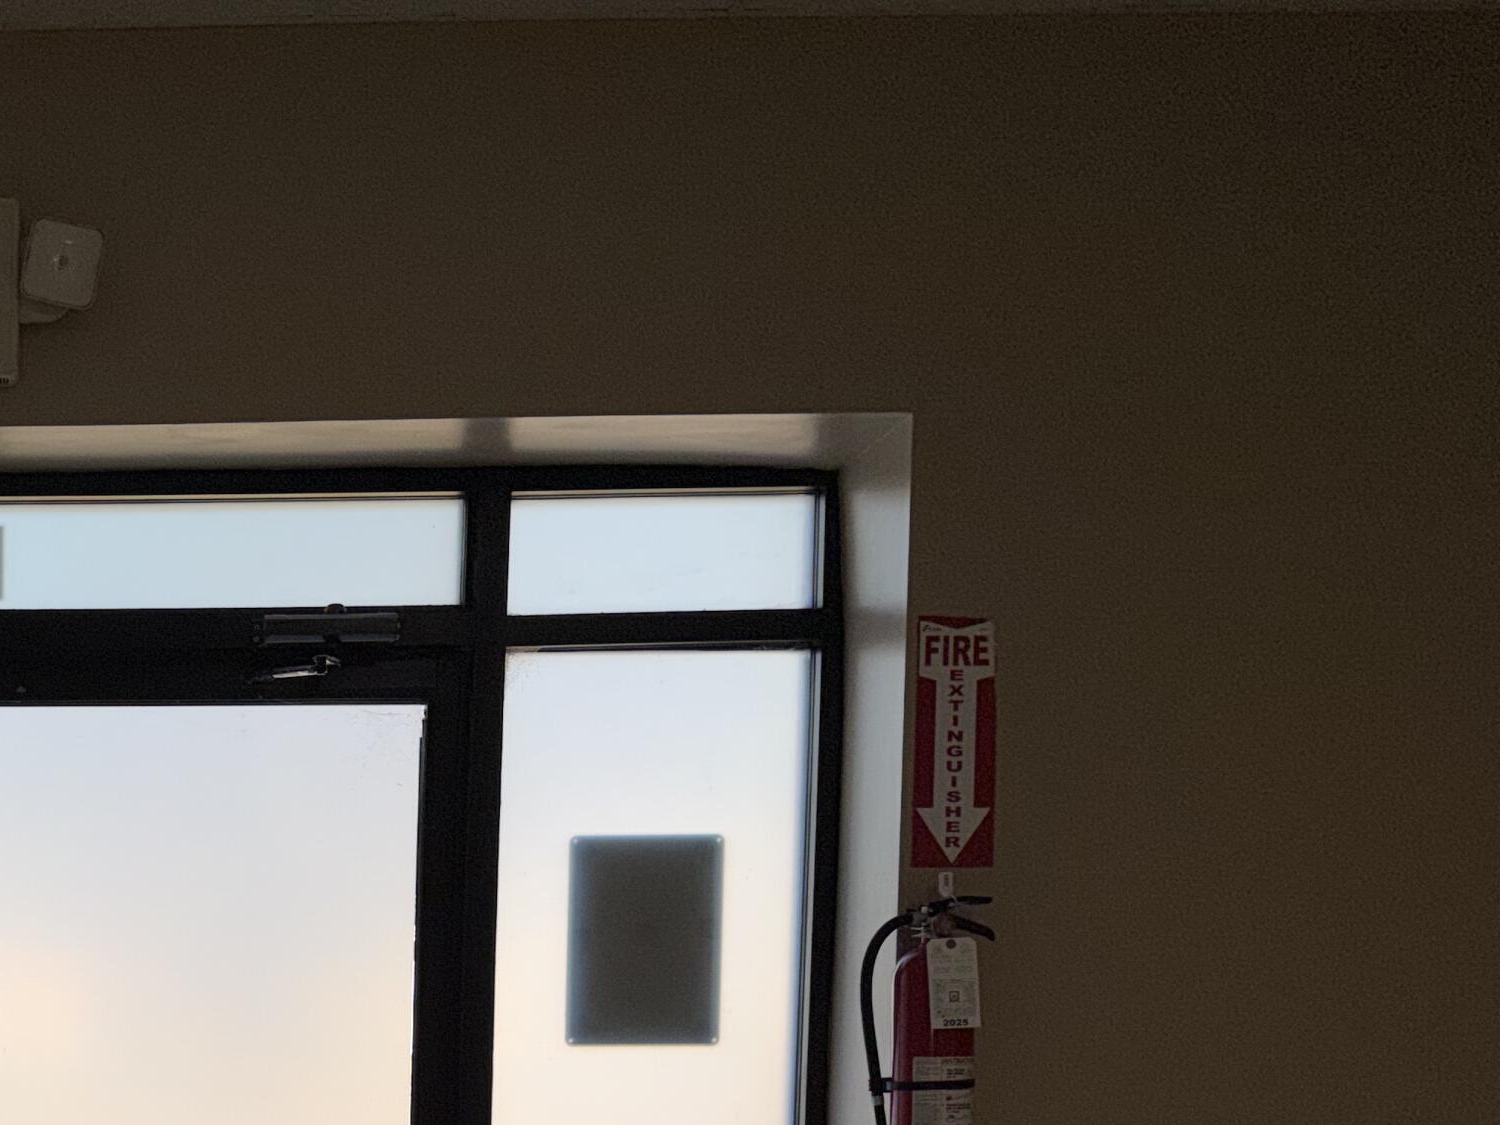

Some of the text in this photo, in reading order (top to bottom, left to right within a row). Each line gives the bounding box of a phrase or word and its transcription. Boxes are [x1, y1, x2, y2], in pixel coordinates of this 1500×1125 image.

[924, 635, 990, 667] FIRE
[944, 669, 965, 848] EXTINGUISHER
[942, 1018, 969, 1027] 2025
